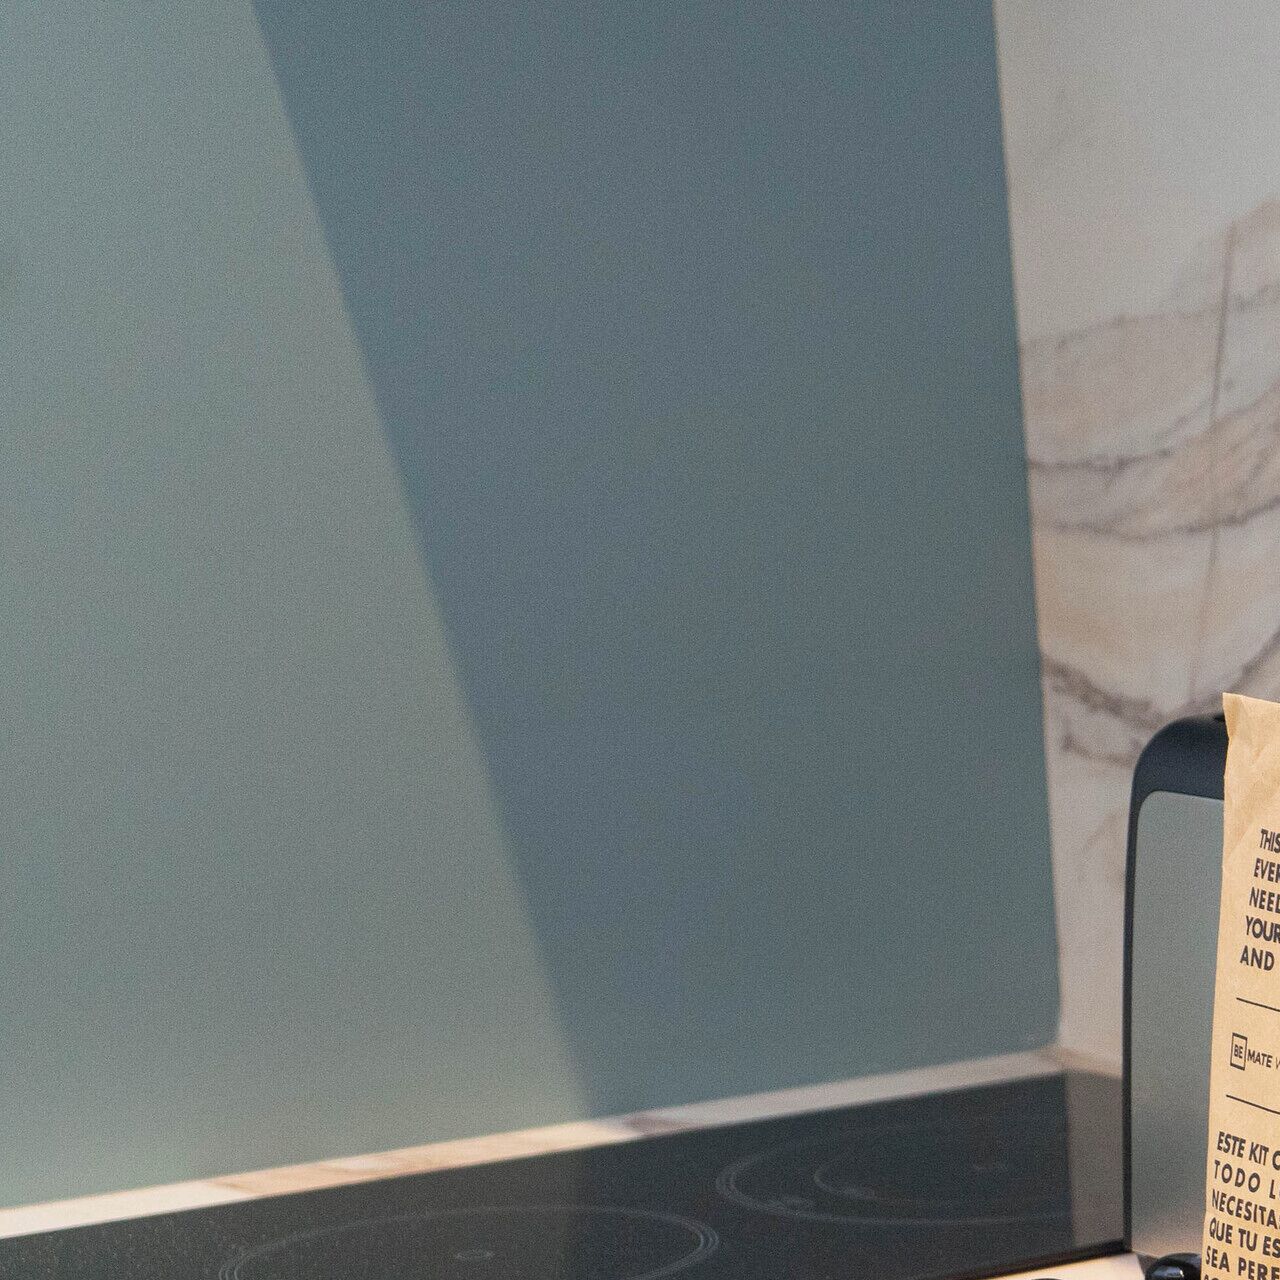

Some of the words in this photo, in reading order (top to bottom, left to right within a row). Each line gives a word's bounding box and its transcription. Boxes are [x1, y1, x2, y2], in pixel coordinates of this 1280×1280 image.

[1239, 945, 1275, 972] AND
[1233, 1044, 1244, 1059] BE
[1246, 1048, 1273, 1068] MATE
[1216, 1131, 1246, 1159] ESTE
[1248, 1141, 1269, 1166] KIT
[1213, 1159, 1261, 1193] TODO
[1209, 1217, 1233, 1245] QUE
[1238, 1228, 1258, 1252] TU
[1205, 1245, 1230, 1273] SEA
